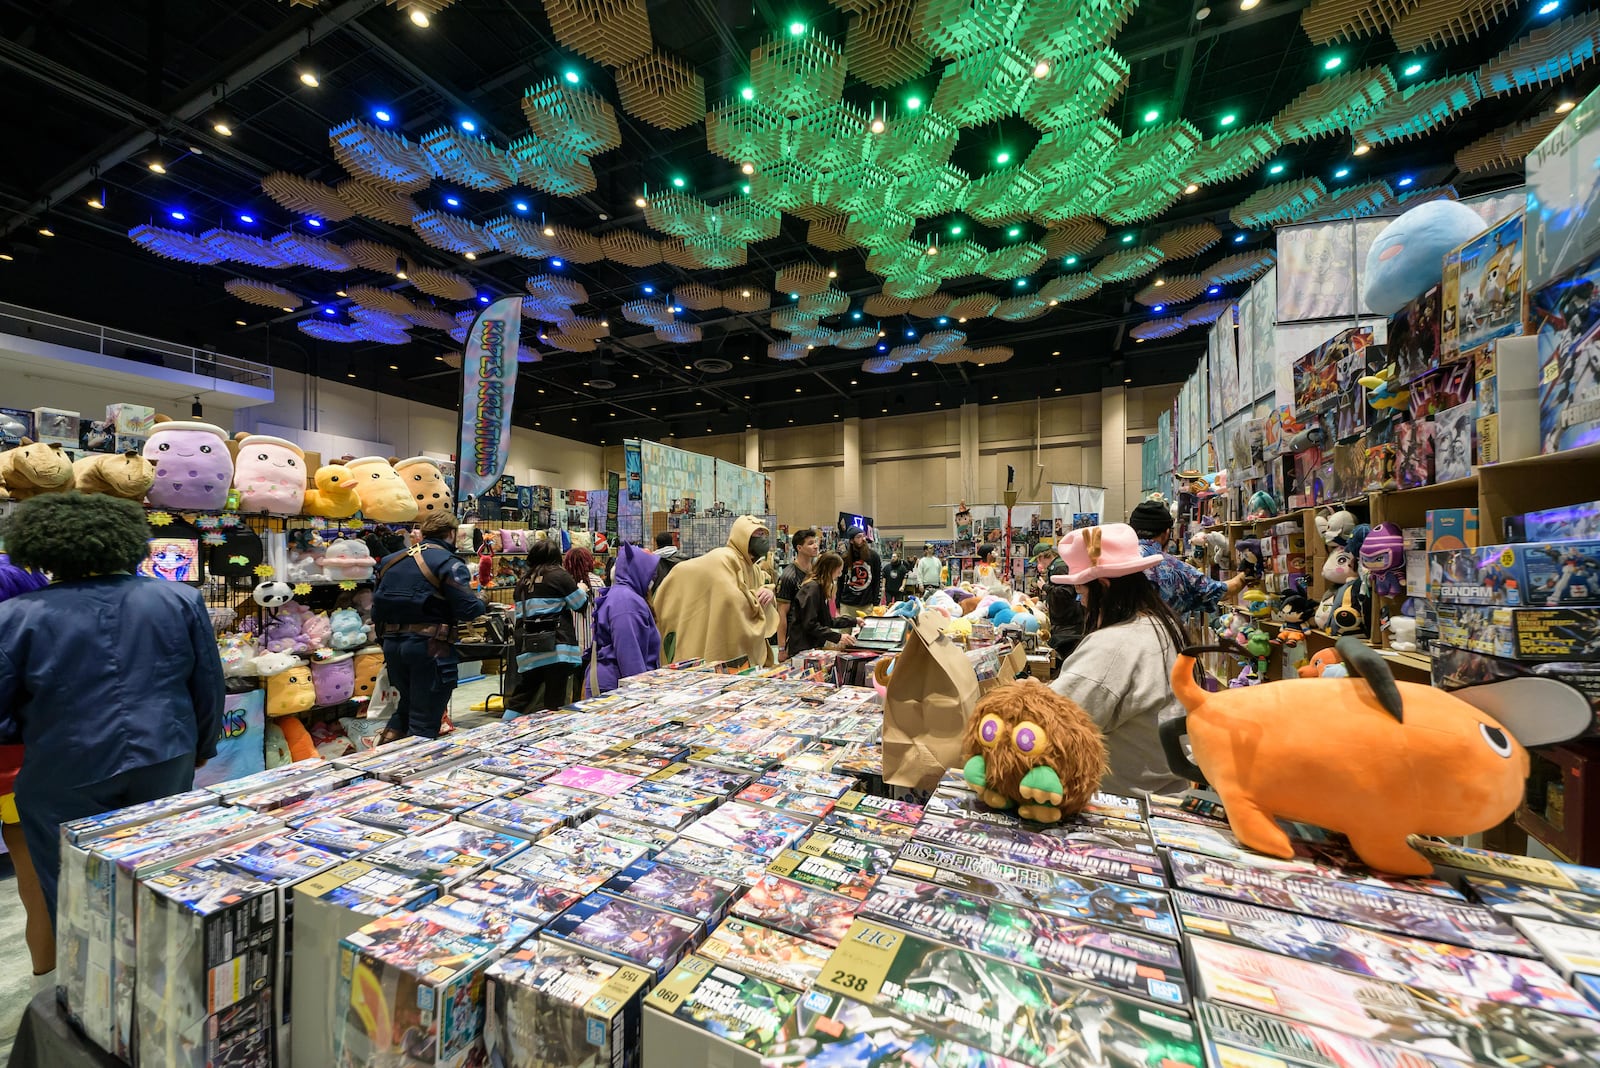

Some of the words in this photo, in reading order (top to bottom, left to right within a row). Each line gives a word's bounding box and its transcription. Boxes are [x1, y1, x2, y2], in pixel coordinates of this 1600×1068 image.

[480, 319, 505, 379] KOPES
[475, 380, 505, 477] KREATIONS
[1441, 585, 1493, 598] GUNDAM
[1520, 632, 1559, 640] FULL
[1521, 646, 1571, 654] MODE
[798, 862, 853, 885] MARASAI
[1049, 851, 1131, 876] GUNDAM
[1204, 859, 1285, 890] GUNDAM
[854, 927, 898, 949] HG
[1034, 936, 1138, 984] GUNDAM
[622, 970, 640, 983] 155
[830, 970, 869, 992] 238
[656, 987, 679, 1004] 060
